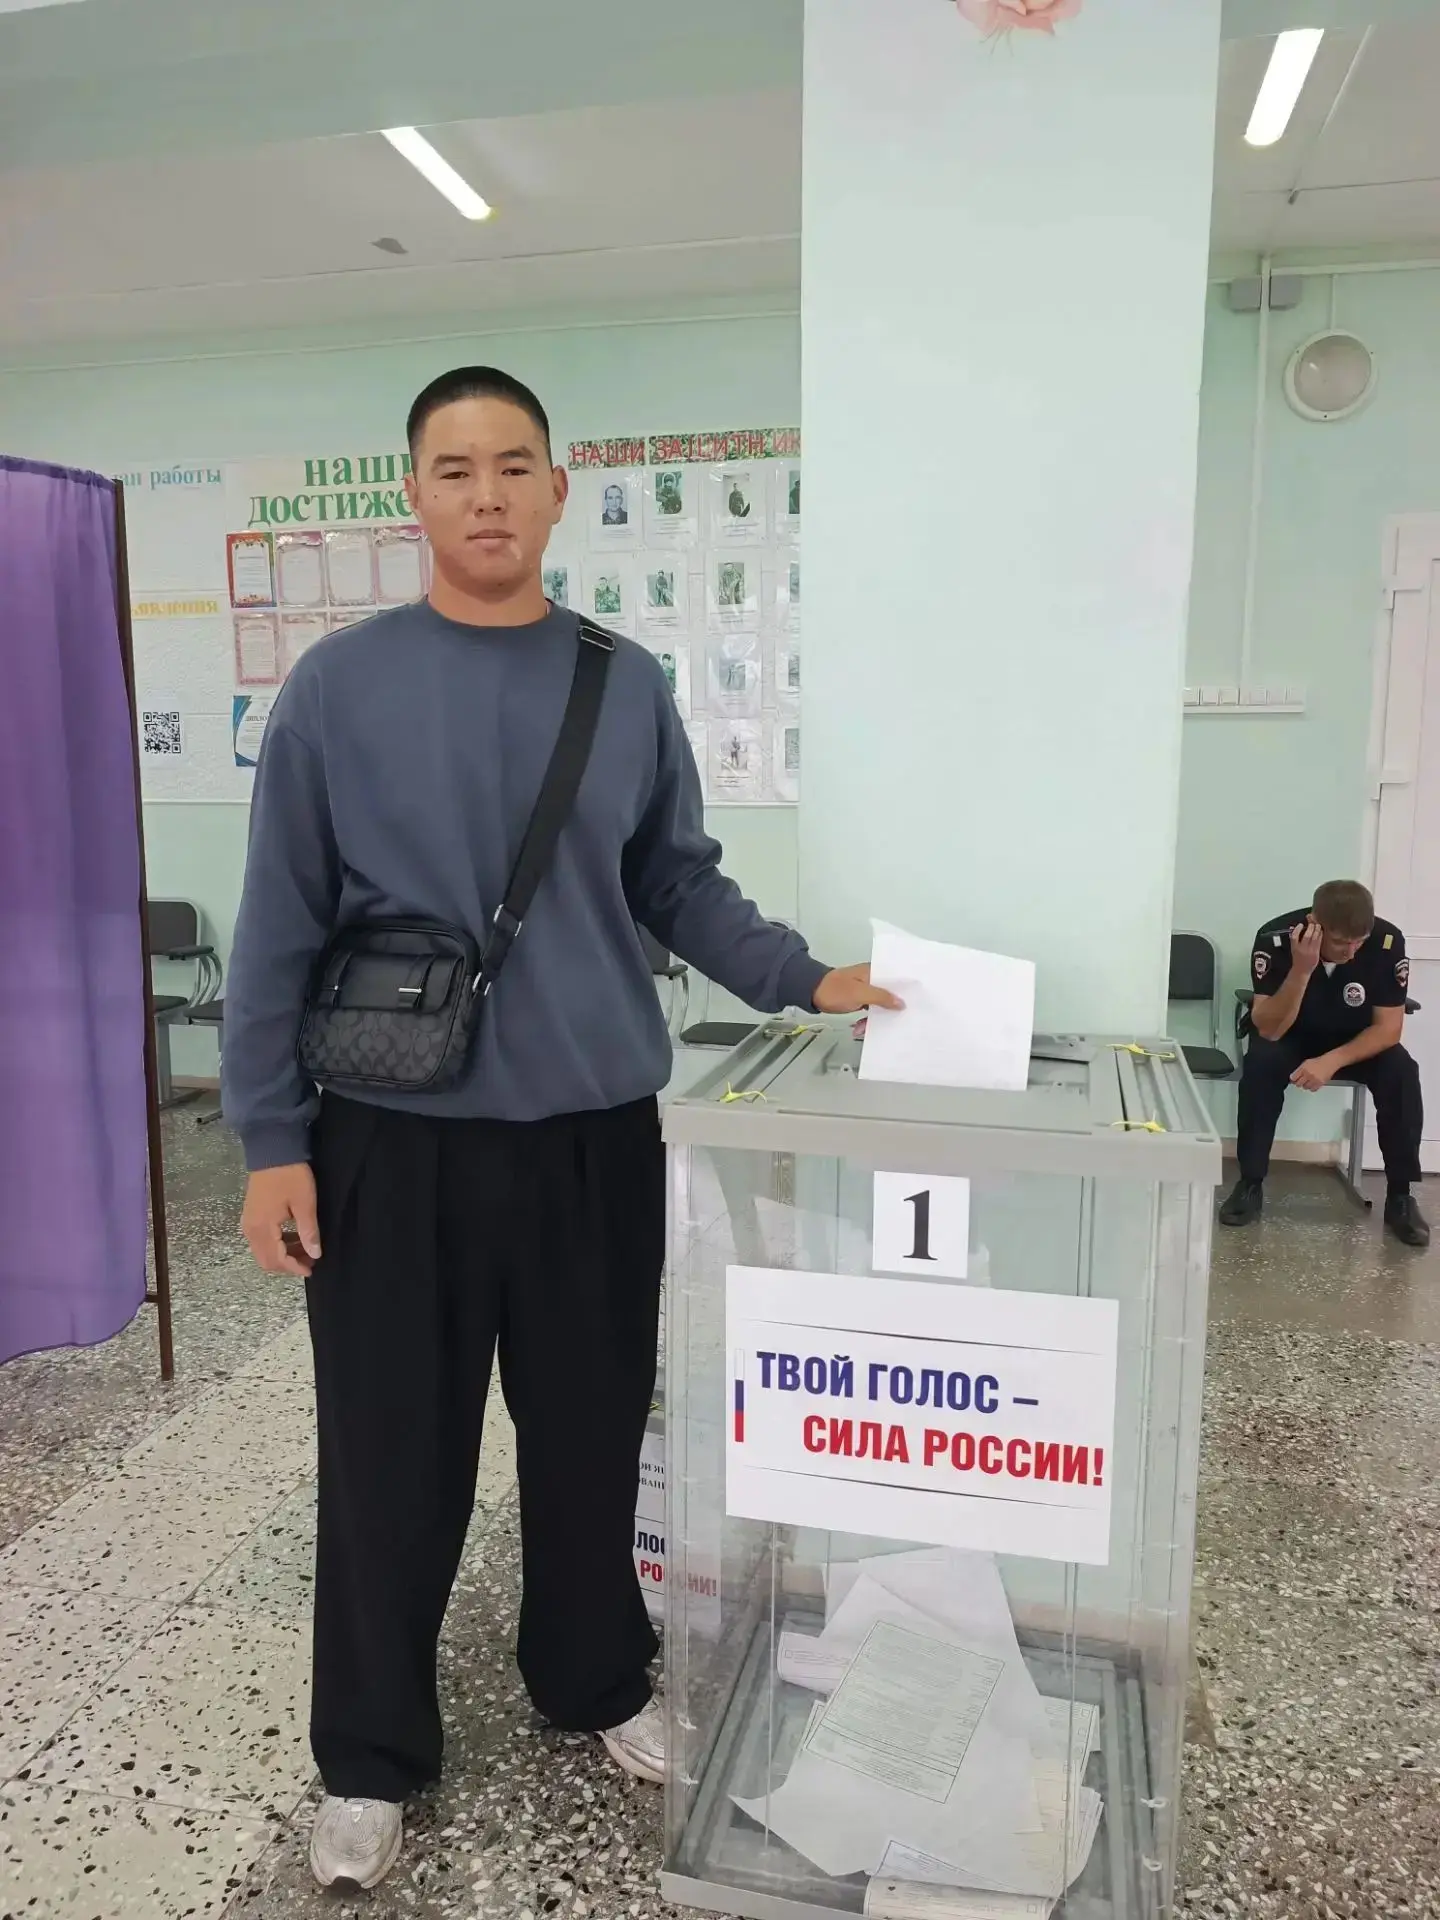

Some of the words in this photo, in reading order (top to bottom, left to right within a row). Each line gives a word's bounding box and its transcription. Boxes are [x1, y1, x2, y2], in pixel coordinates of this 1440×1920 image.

[149, 465, 222, 490] работы
[571, 440, 645, 465] НАШИ
[902, 1189, 938, 1261] 1
[756, 1350, 854, 1399] ТВОЙ
[868, 1362, 999, 1414] ГОЛОС
[803, 1414, 910, 1464] СИЛА
[923, 1427, 1104, 1487] РОССИИ!
